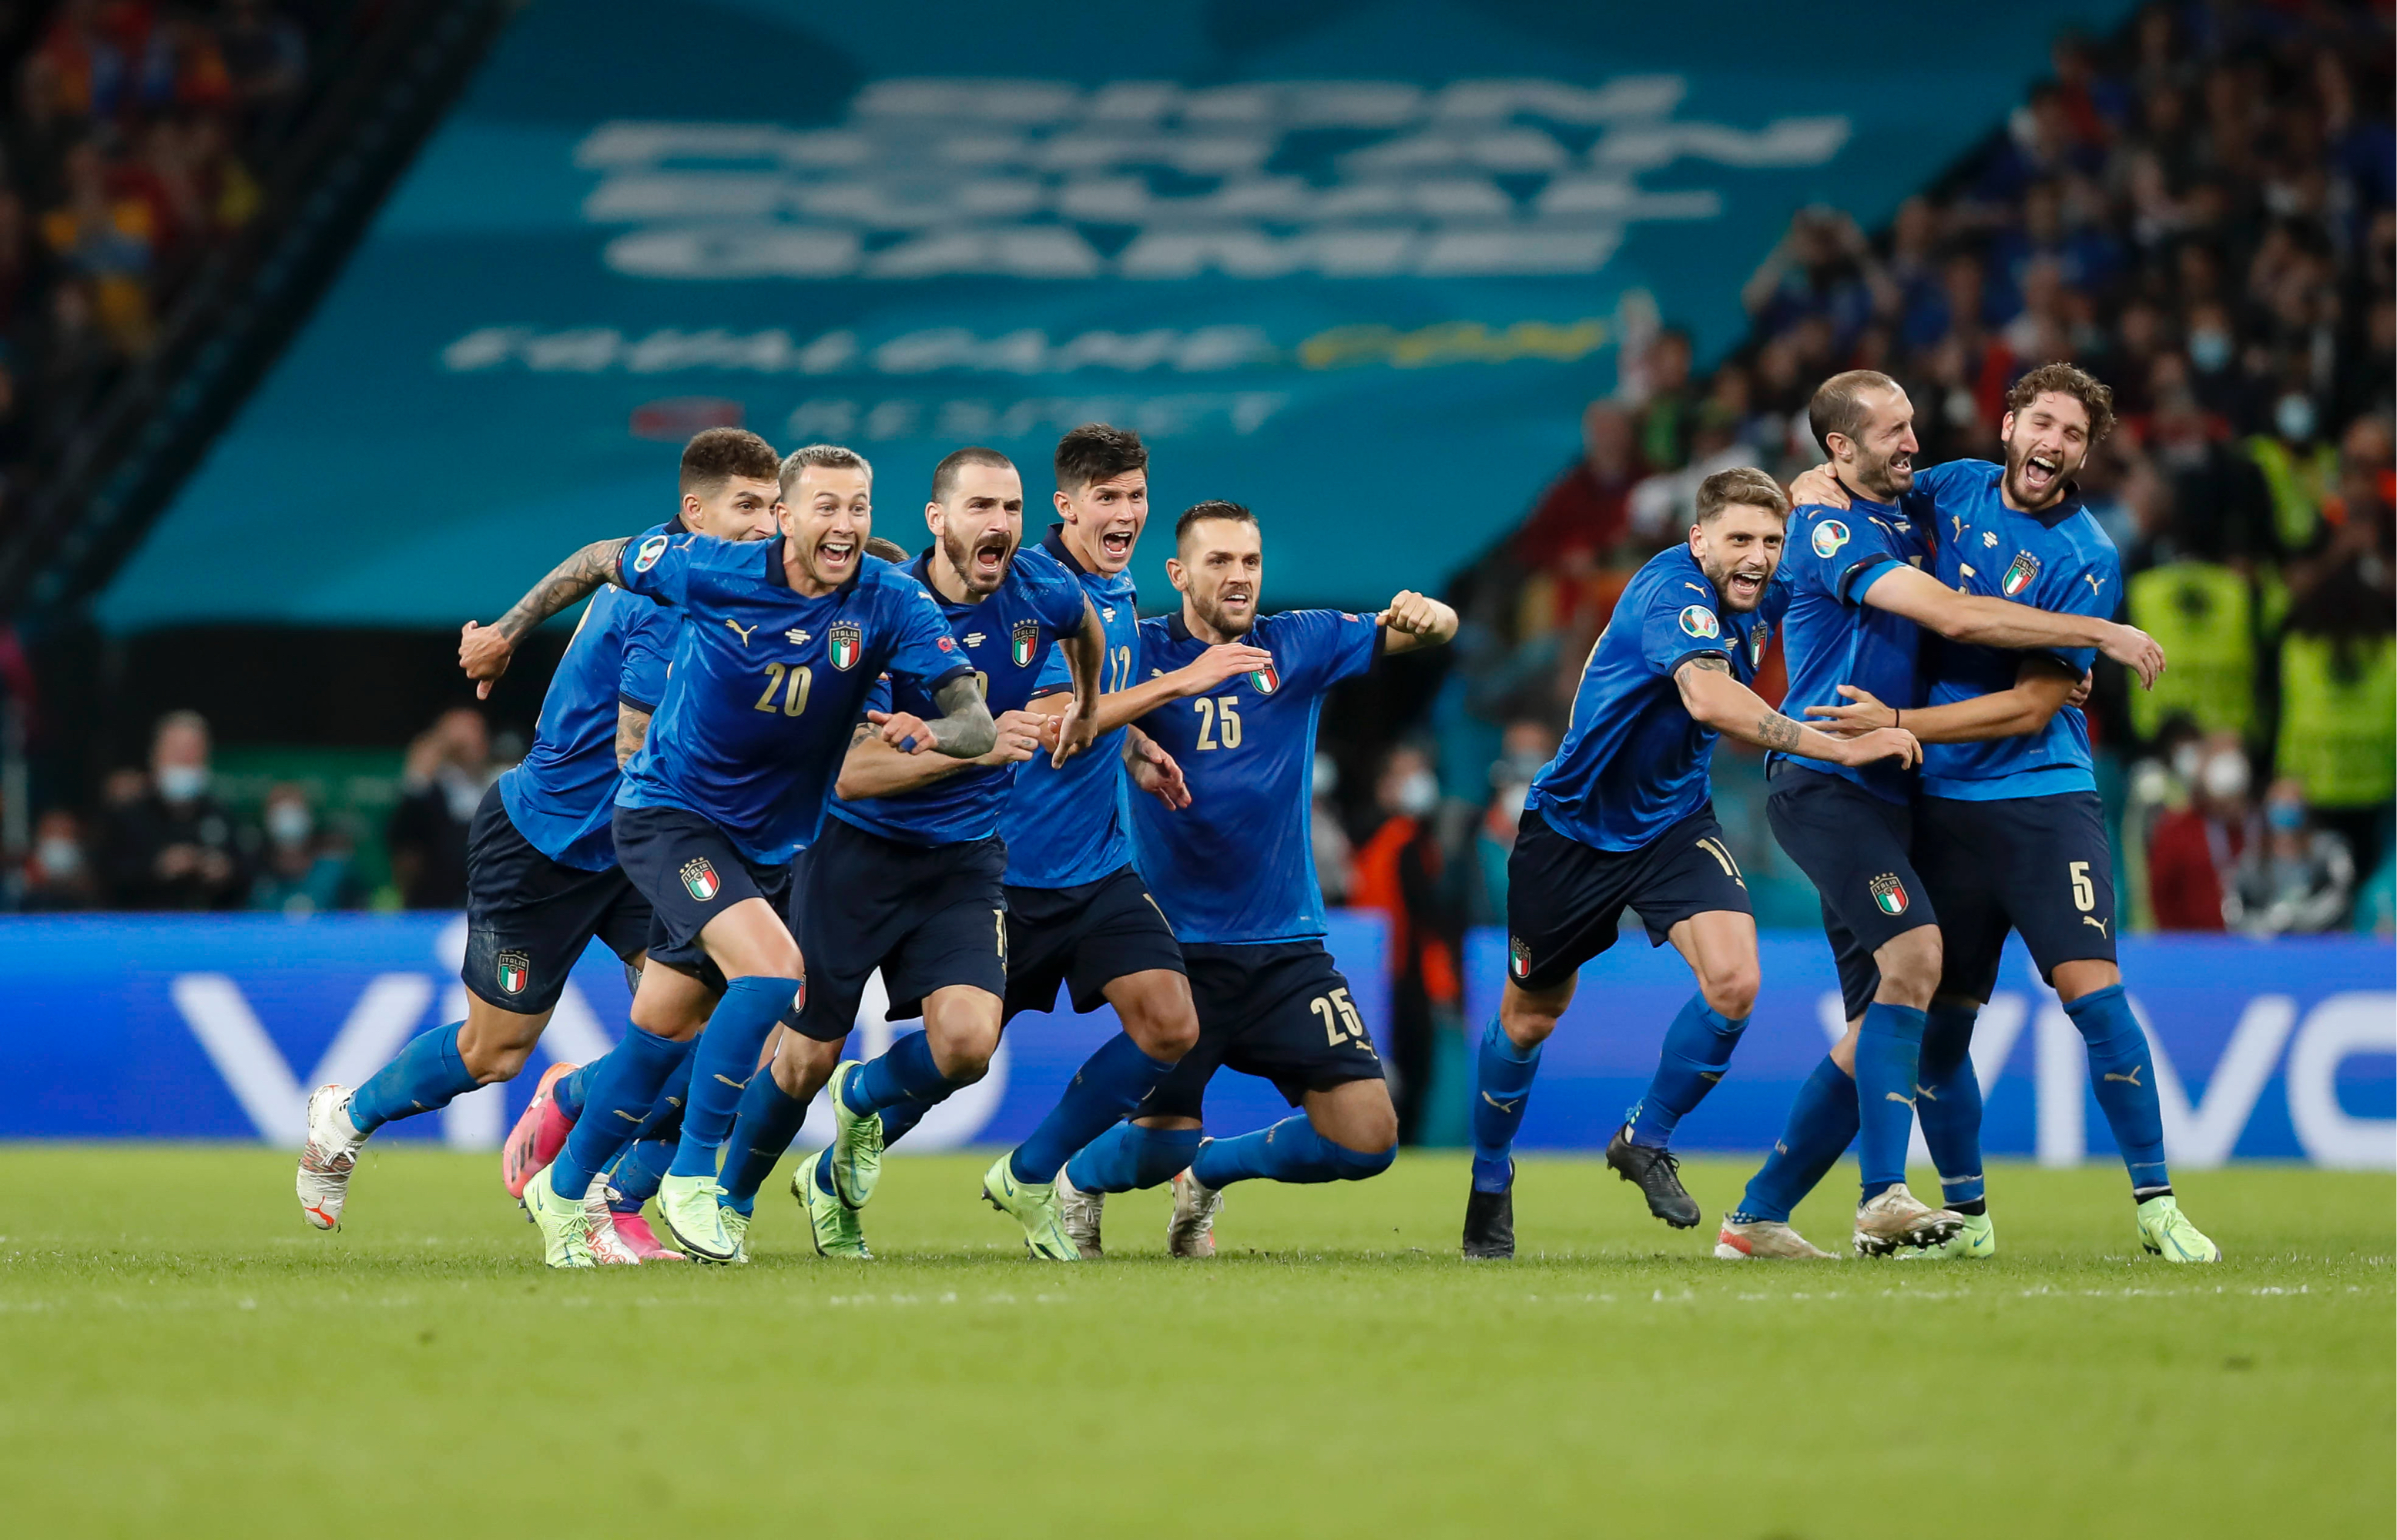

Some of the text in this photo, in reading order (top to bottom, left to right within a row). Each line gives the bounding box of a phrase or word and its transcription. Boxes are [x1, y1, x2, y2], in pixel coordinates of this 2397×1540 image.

[1014, 628, 1036, 638] ITALIA
[754, 662, 812, 717] 20
[1109, 645, 1131, 694] 12
[1195, 696, 1241, 750] 25
[685, 863, 709, 881] ITALIA
[1874, 879, 1897, 893] ITALIA
[2070, 862, 2095, 912] 5
[501, 957, 526, 968] ITALIA
[1310, 987, 1363, 1046] 25
